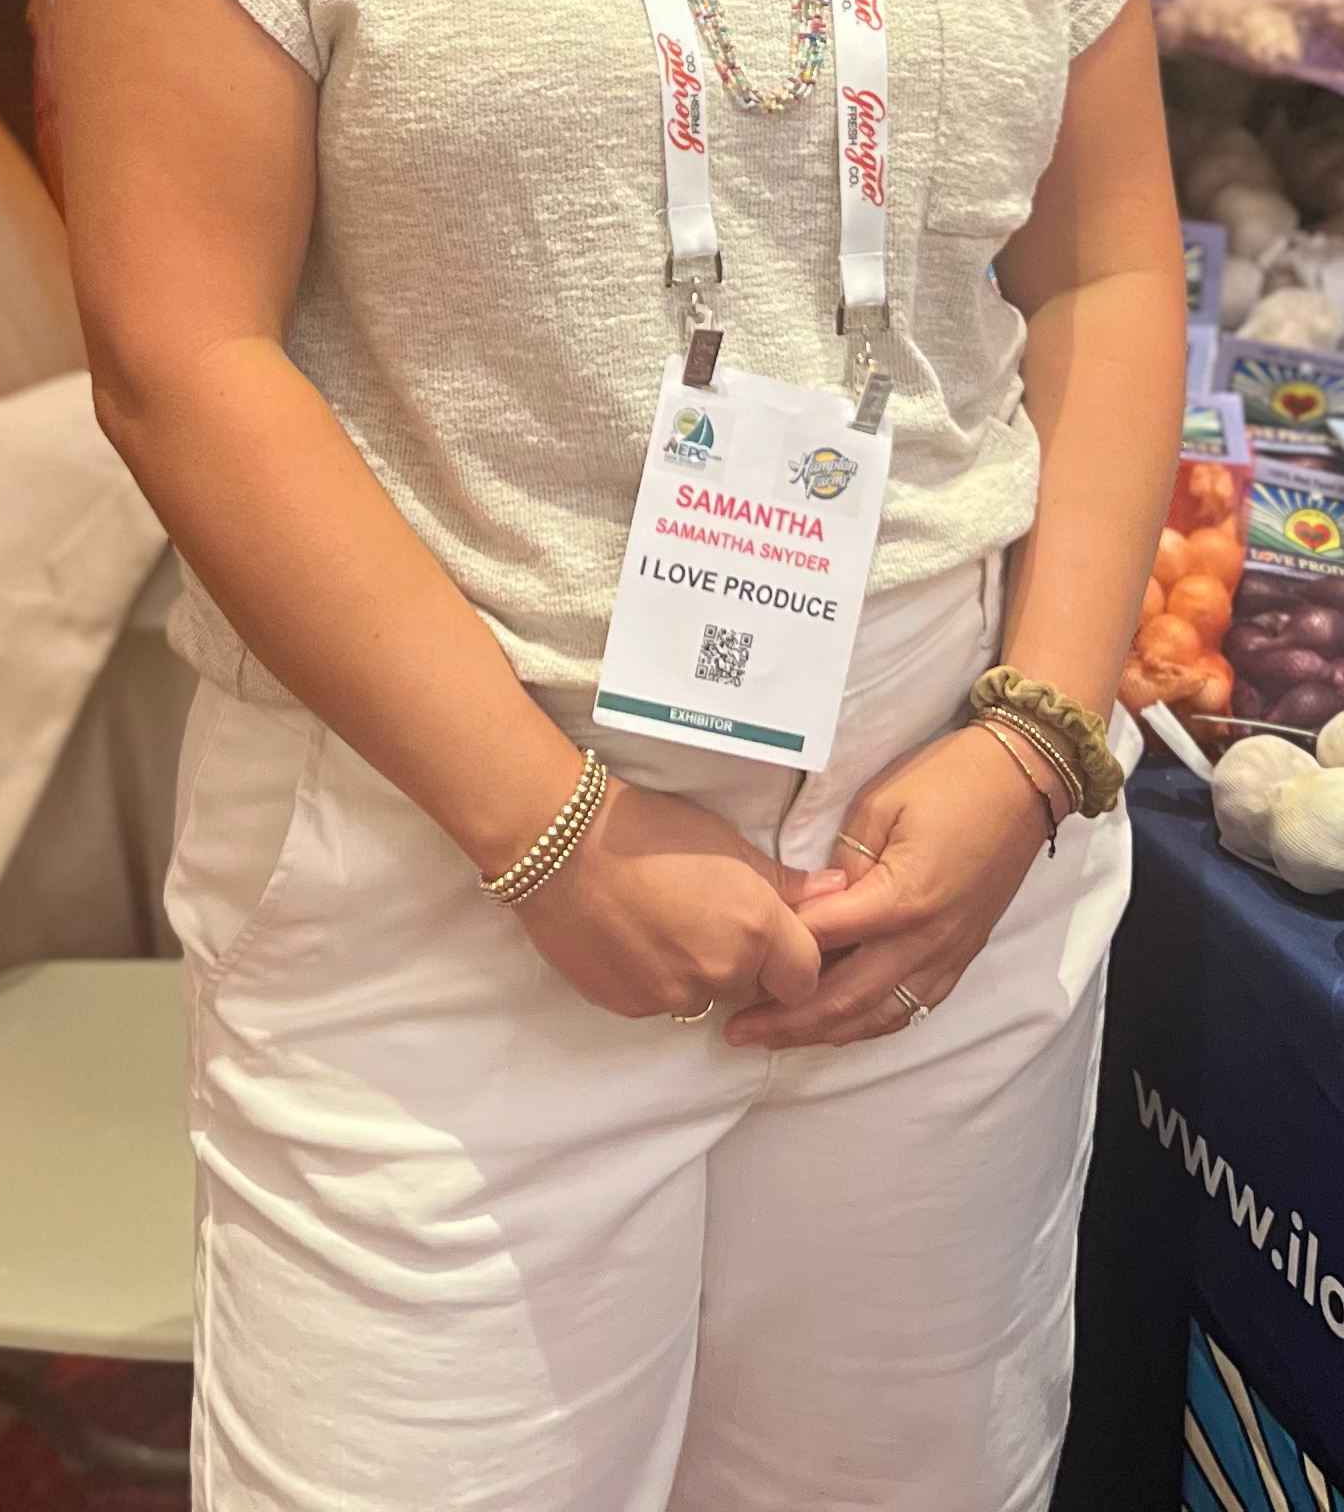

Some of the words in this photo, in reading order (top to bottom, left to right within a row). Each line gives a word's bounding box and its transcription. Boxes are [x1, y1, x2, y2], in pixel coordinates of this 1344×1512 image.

[657, 32, 705, 154] Giorgio
[842, 86, 886, 207] Giorgio
[847, 106, 857, 145] FRESH
[676, 484, 824, 542] SAMANTHA
[656, 517, 755, 556] SAMANTHA
[760, 543, 830, 574] SNYDER
[640, 555, 648, 576] I
[653, 559, 718, 593] LOVE
[723, 576, 838, 622] PRODUCE
[670, 708, 733, 732] EXHIBITOR
